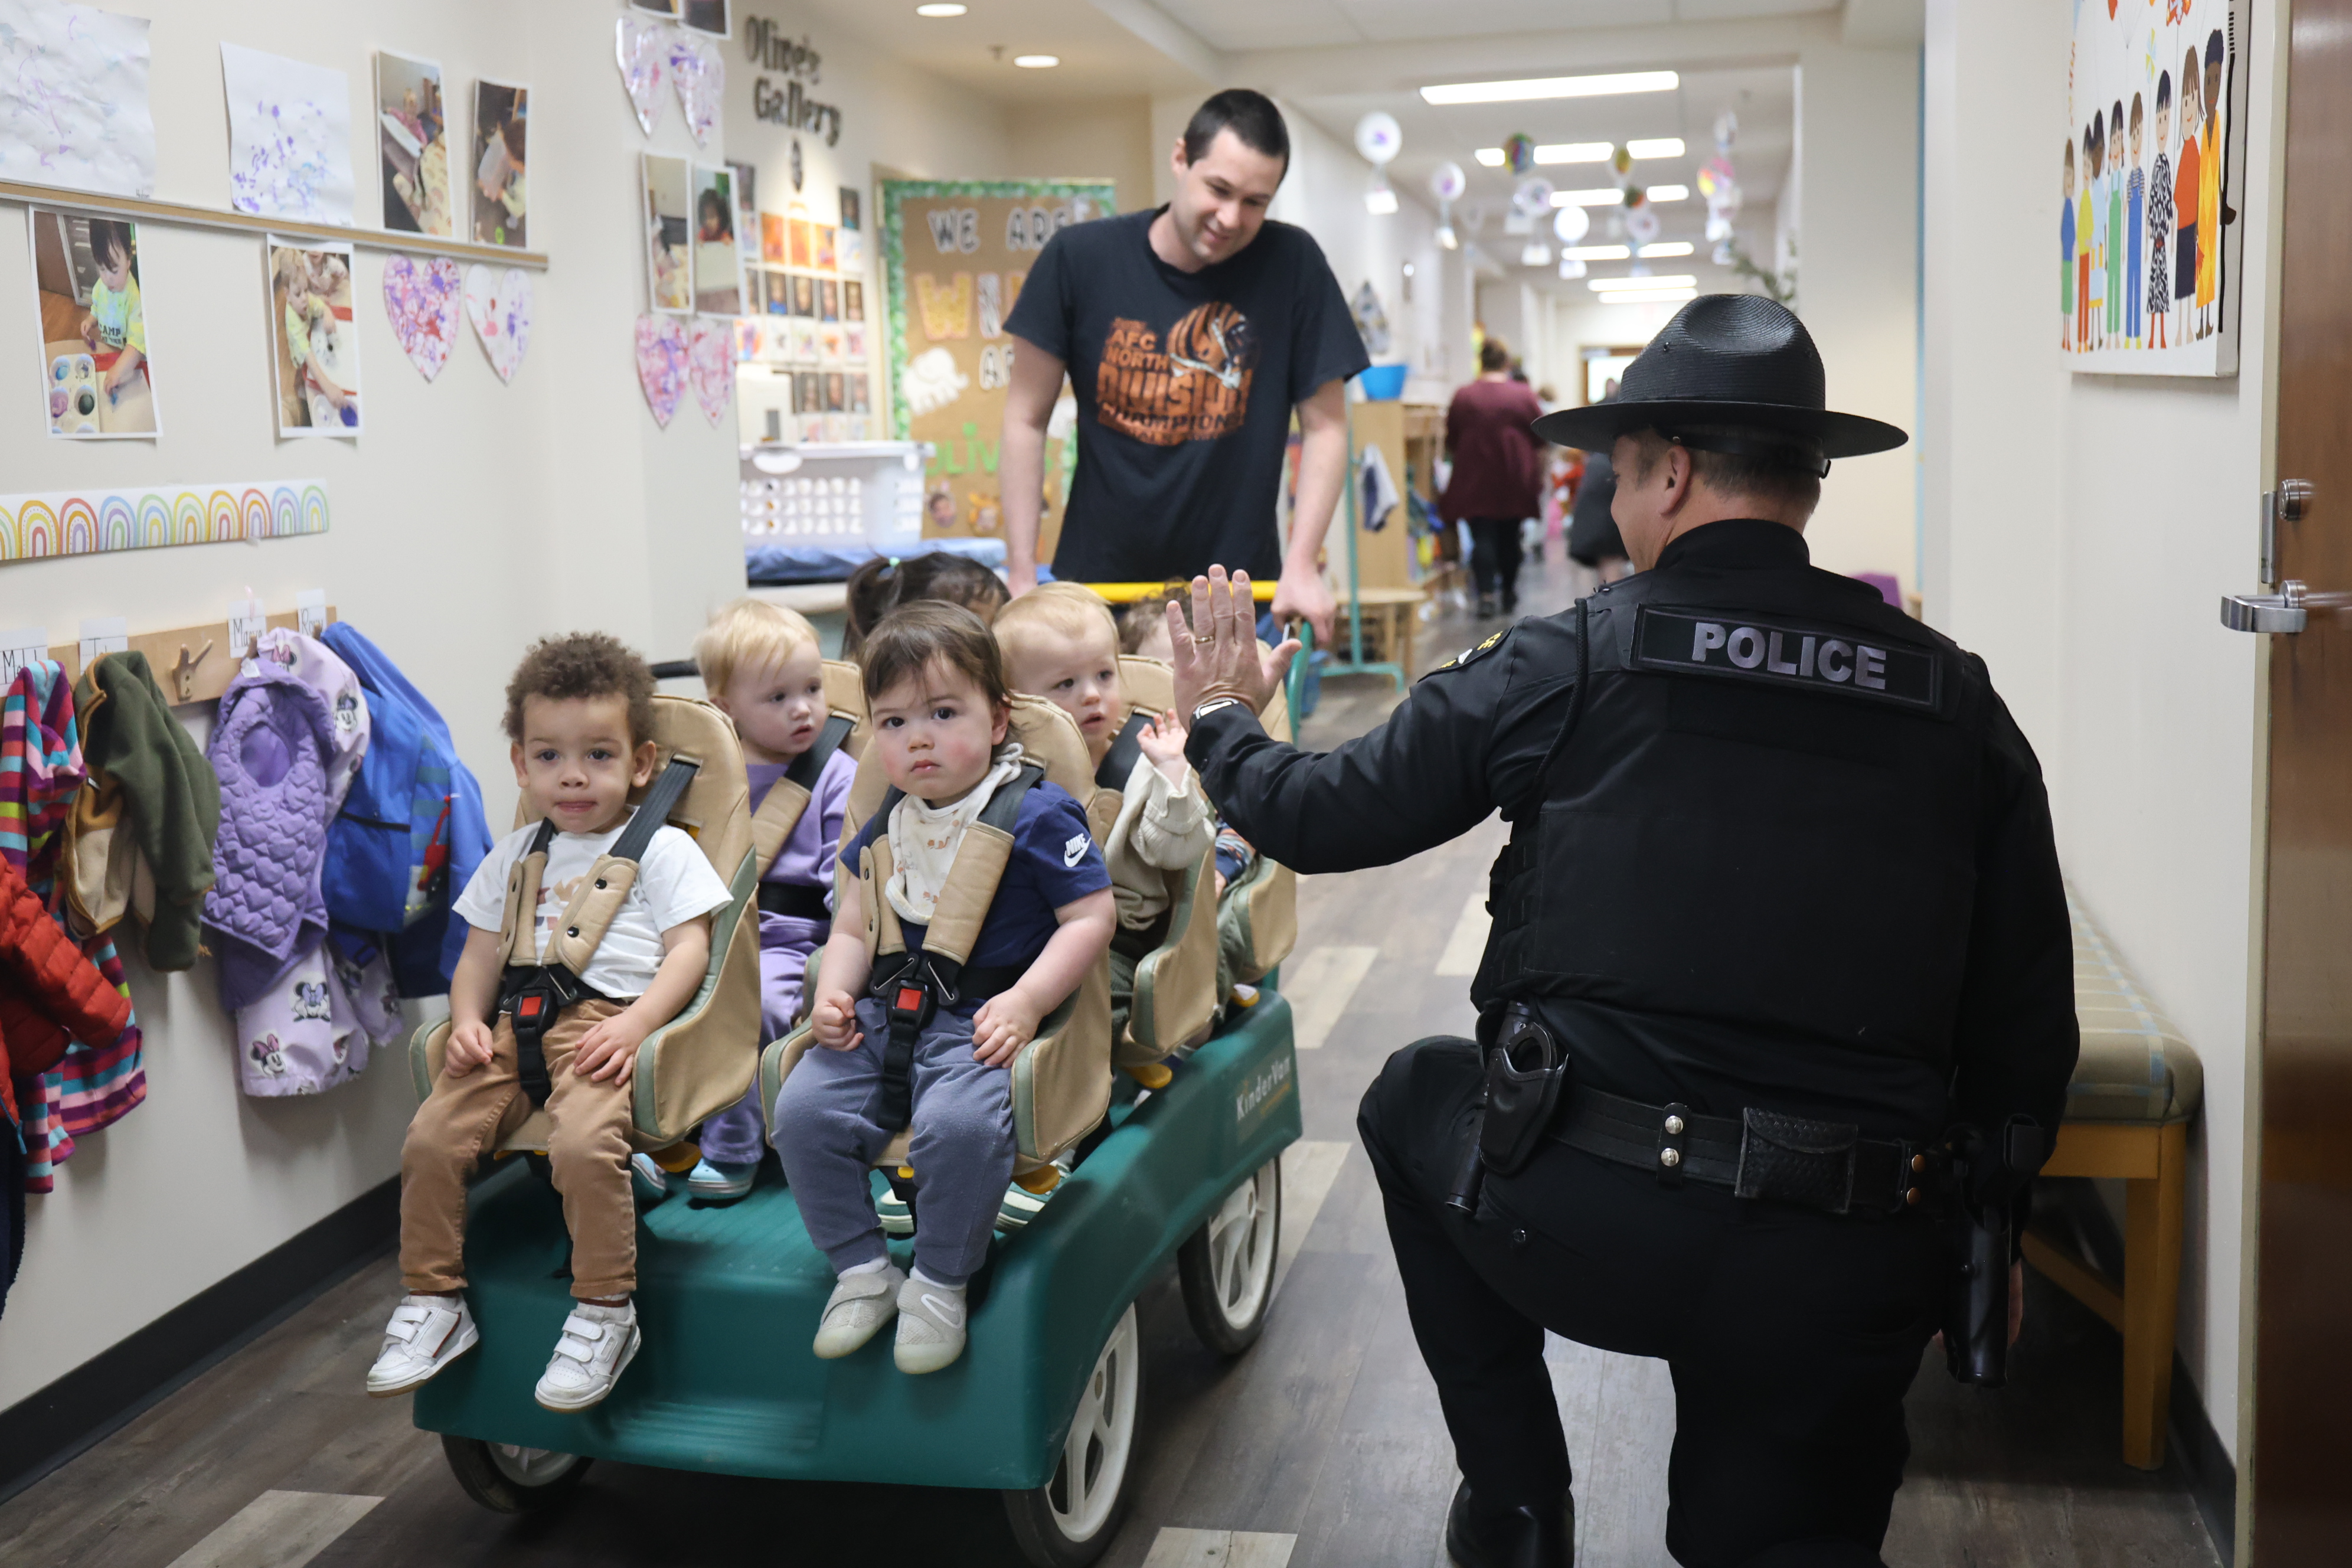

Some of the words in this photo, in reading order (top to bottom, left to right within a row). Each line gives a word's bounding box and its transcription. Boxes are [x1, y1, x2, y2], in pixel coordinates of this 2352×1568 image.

[754, 77, 841, 148] Gallery
[927, 207, 980, 254] WE
[1105, 345, 1170, 371] NORTH
[1110, 329, 1156, 351] AFC
[1691, 622, 1887, 690] POLICE
[1066, 833, 1086, 857] NIKE
[1236, 1055, 1291, 1121] KinderVan
